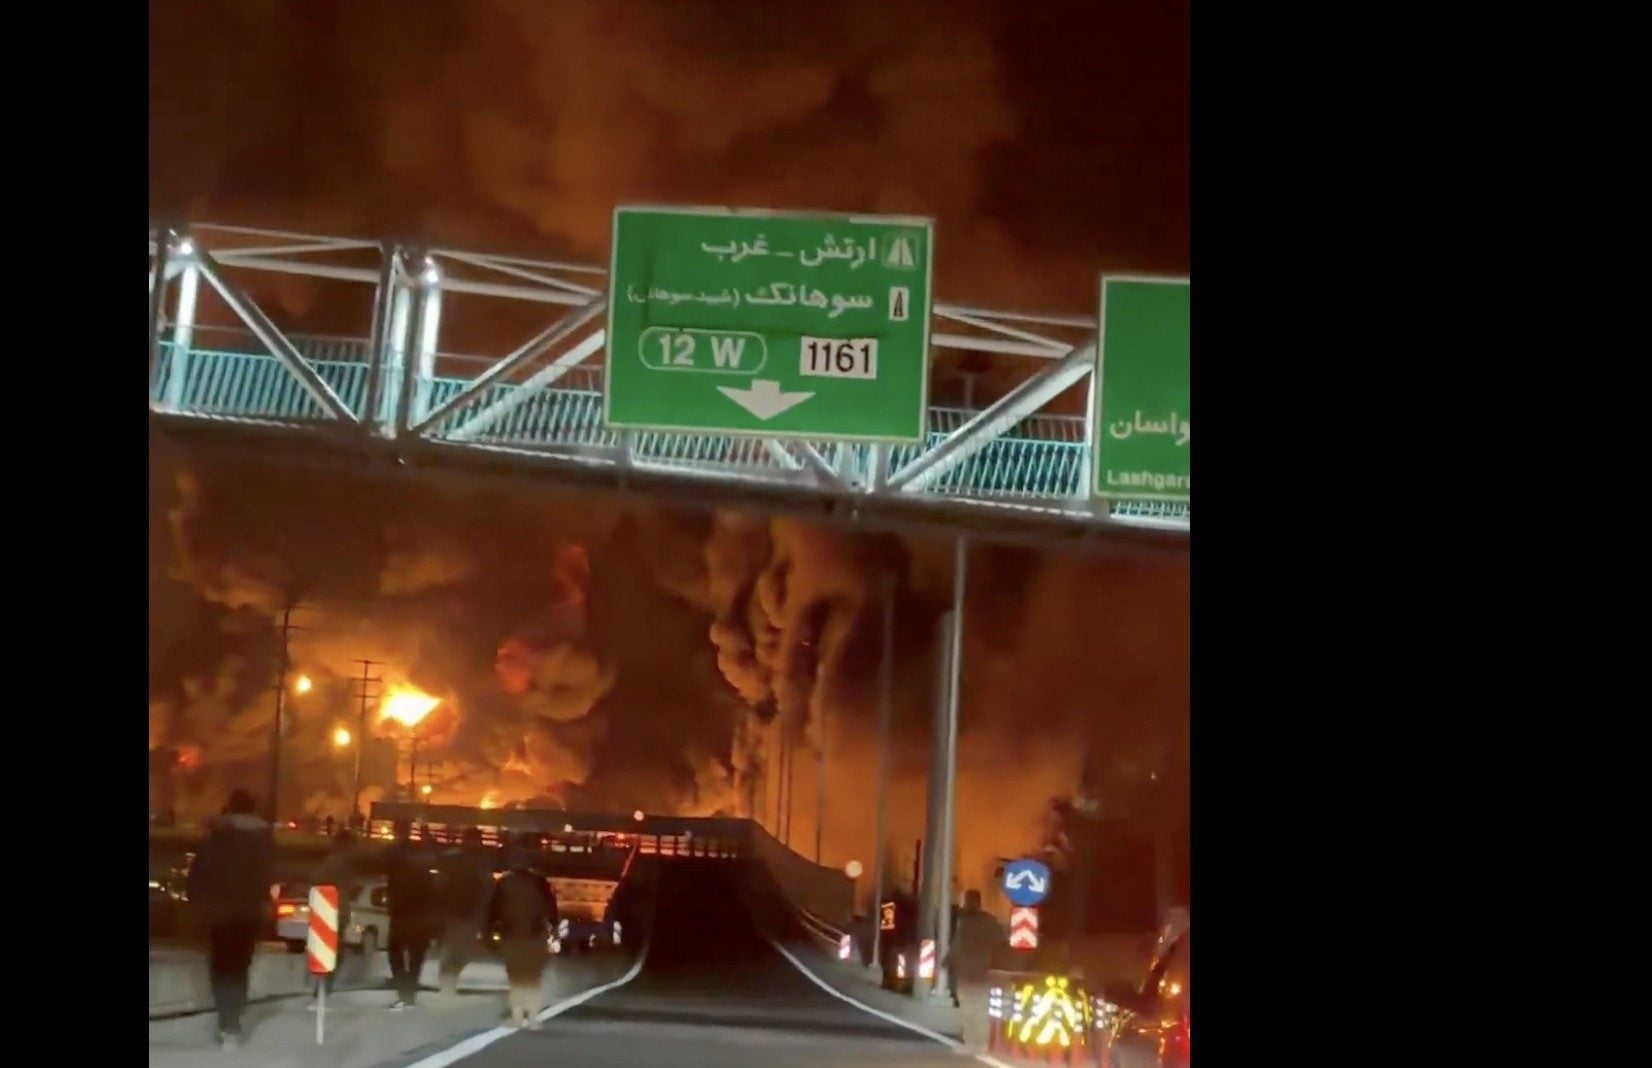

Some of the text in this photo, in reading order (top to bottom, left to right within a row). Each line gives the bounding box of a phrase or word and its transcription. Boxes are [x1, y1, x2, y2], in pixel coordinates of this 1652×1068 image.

[701, 233, 769, 263] غرب
[800, 232, 876, 270] ارتش
[659, 333, 745, 368] 12 W
[808, 341, 870, 374] 1161
